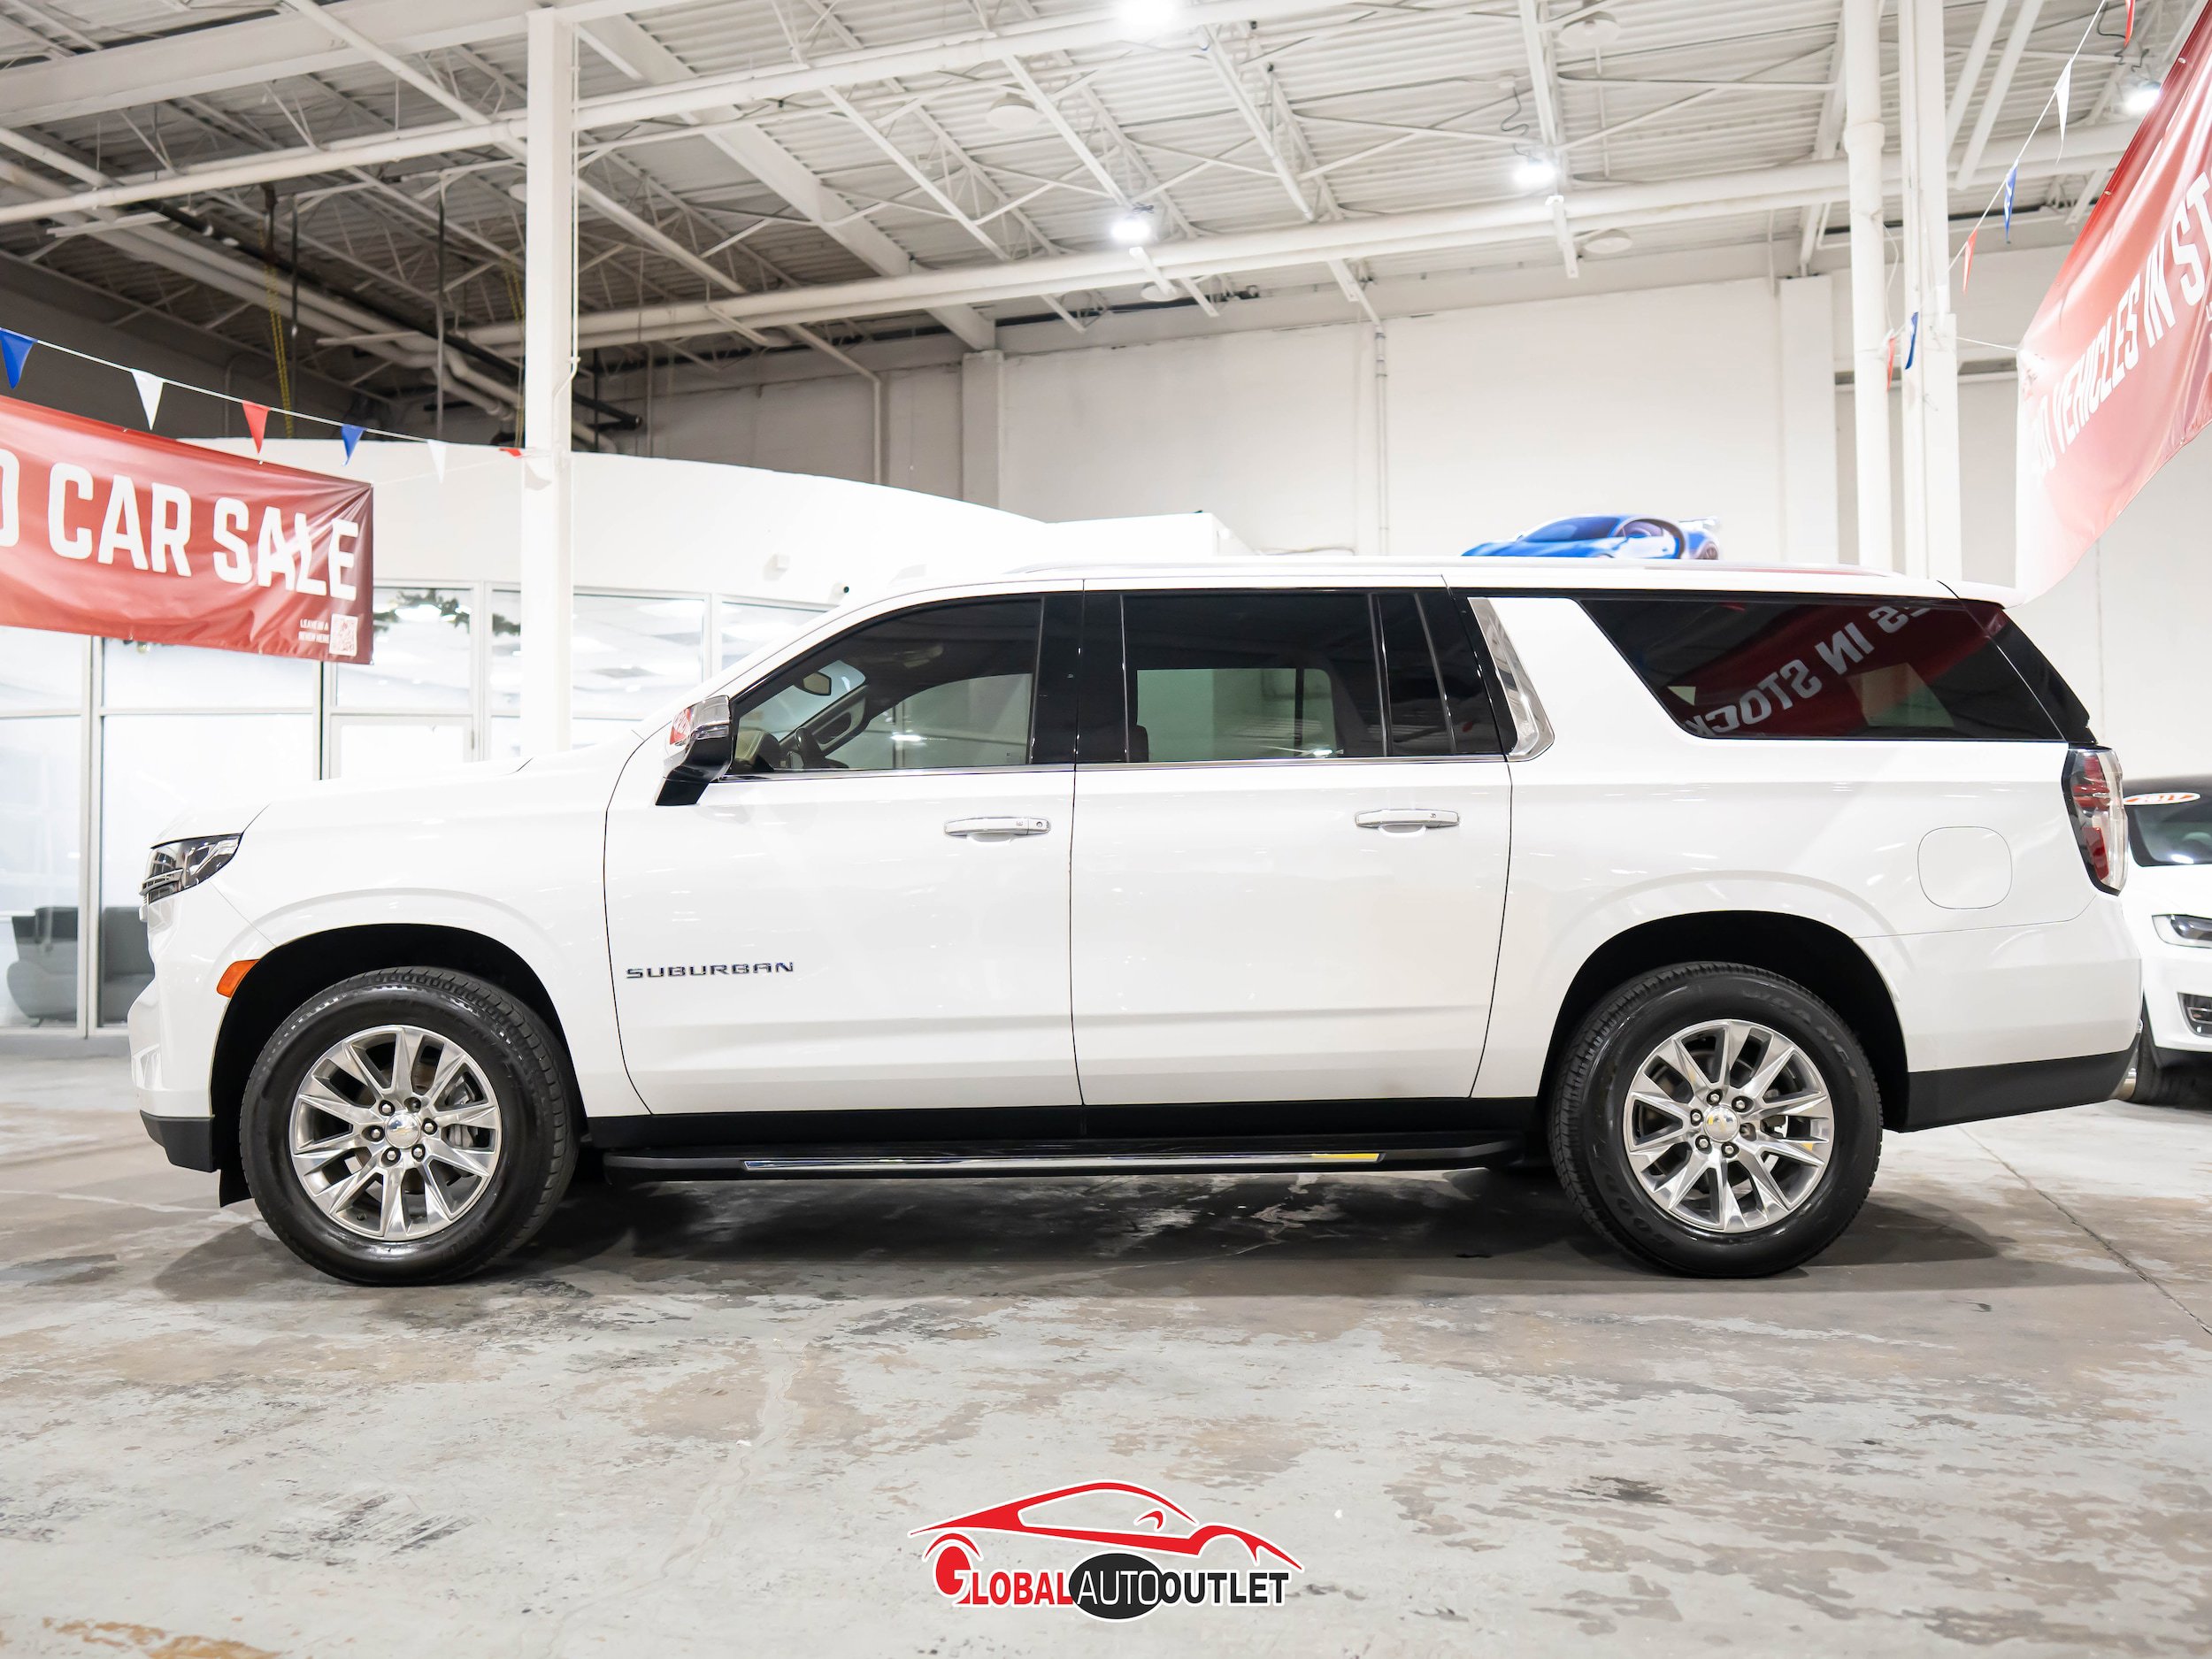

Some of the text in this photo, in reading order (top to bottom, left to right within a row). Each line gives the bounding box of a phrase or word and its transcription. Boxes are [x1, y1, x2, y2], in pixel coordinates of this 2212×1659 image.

[2052, 273, 2142, 455] VEHICLES
[2143, 228, 2176, 349] IN
[48, 462, 192, 577] CAR
[212, 496, 359, 602] SALE
[626, 961, 794, 979] SUBURBAN
